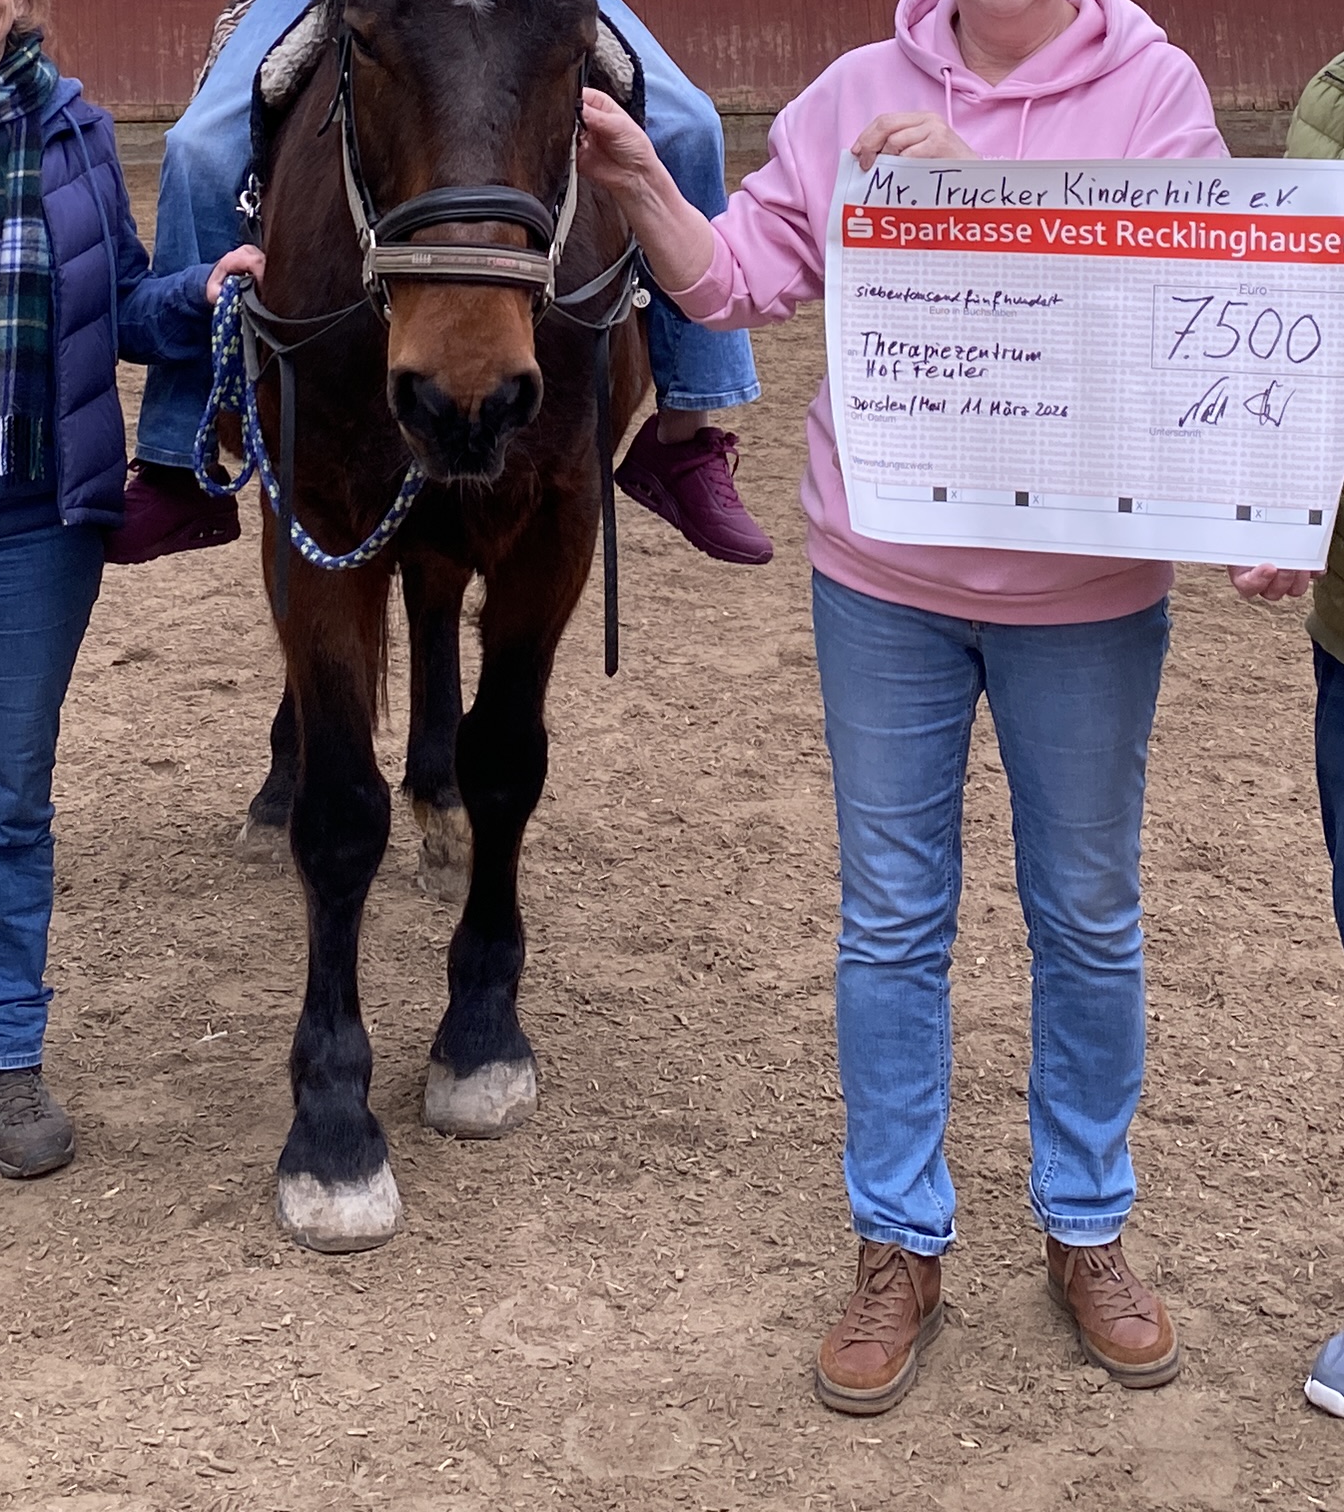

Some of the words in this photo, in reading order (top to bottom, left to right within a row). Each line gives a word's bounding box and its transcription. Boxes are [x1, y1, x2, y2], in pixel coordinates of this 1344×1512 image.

[863, 168, 918, 206] Mr.
[929, 169, 1048, 209] Trucker
[1064, 171, 1230, 208] Kinderhilfe
[880, 216, 1033, 246] Sparkasse
[1040, 218, 1107, 246] Vest
[1239, 284, 1267, 296] Euro
[636, 295, 647, 305] 10
[929, 306, 950, 315] Euro
[963, 306, 1018, 318] Buchstaben
[860, 331, 1042, 364] Therapiezentrum
[867, 359, 904, 381] Hof
[990, 401, 1029, 417] März
[868, 413, 896, 422] Datum
[1149, 427, 1202, 438] Unterschrift
[852, 456, 933, 471] Verwendungszweck
